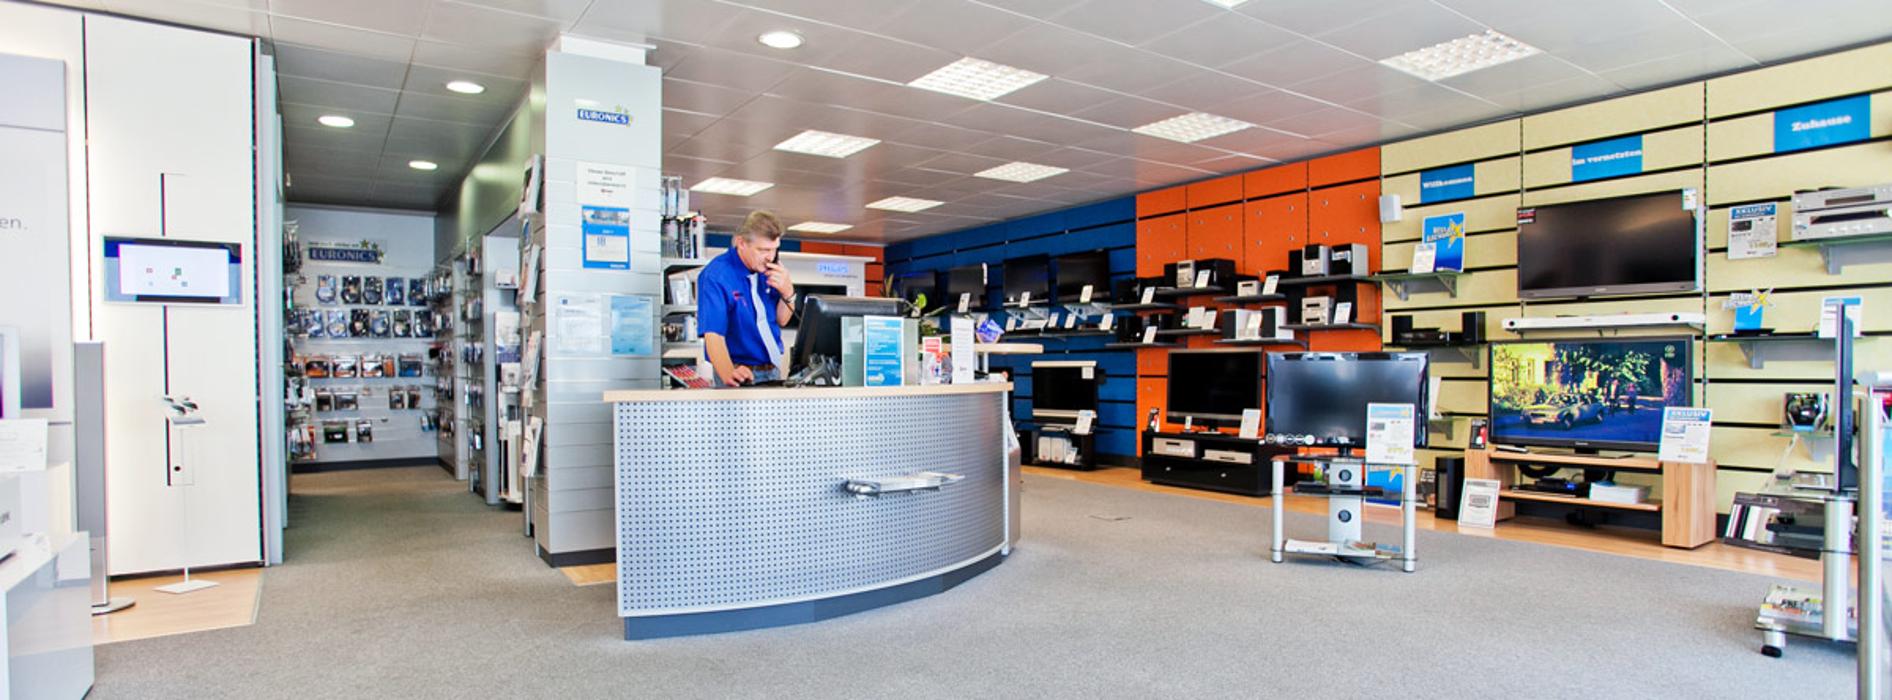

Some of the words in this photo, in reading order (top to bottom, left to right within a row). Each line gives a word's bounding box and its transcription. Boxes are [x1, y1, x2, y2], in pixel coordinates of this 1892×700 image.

[580, 109, 627, 124] EURONICS
[1791, 115, 1852, 132] Zuhause
[1587, 149, 1643, 164] vernetzten
[1422, 176, 1473, 189] Willkommen
[311, 248, 376, 261] EURONICS
